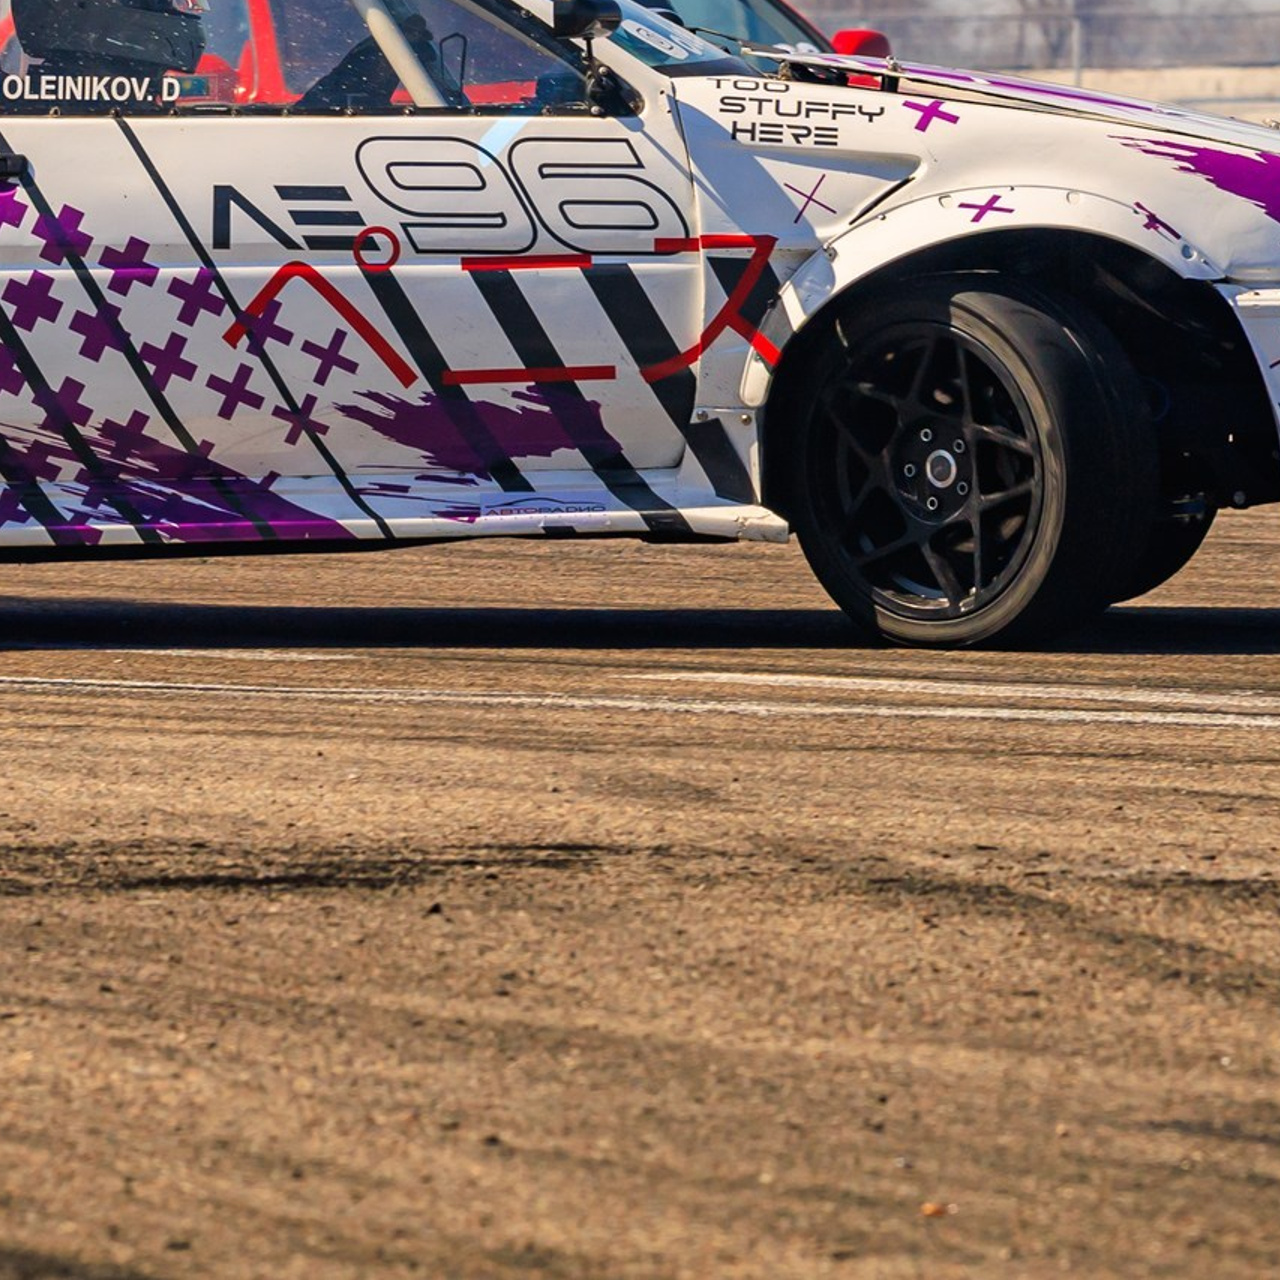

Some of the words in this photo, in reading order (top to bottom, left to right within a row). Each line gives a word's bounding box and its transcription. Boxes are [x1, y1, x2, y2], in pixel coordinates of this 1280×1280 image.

[2, 74, 153, 102] OLEINIKOV.
[161, 77, 181, 102] D
[706, 77, 790, 94] TOO
[719, 95, 886, 123] STUFFY
[731, 120, 839, 146] HERE
